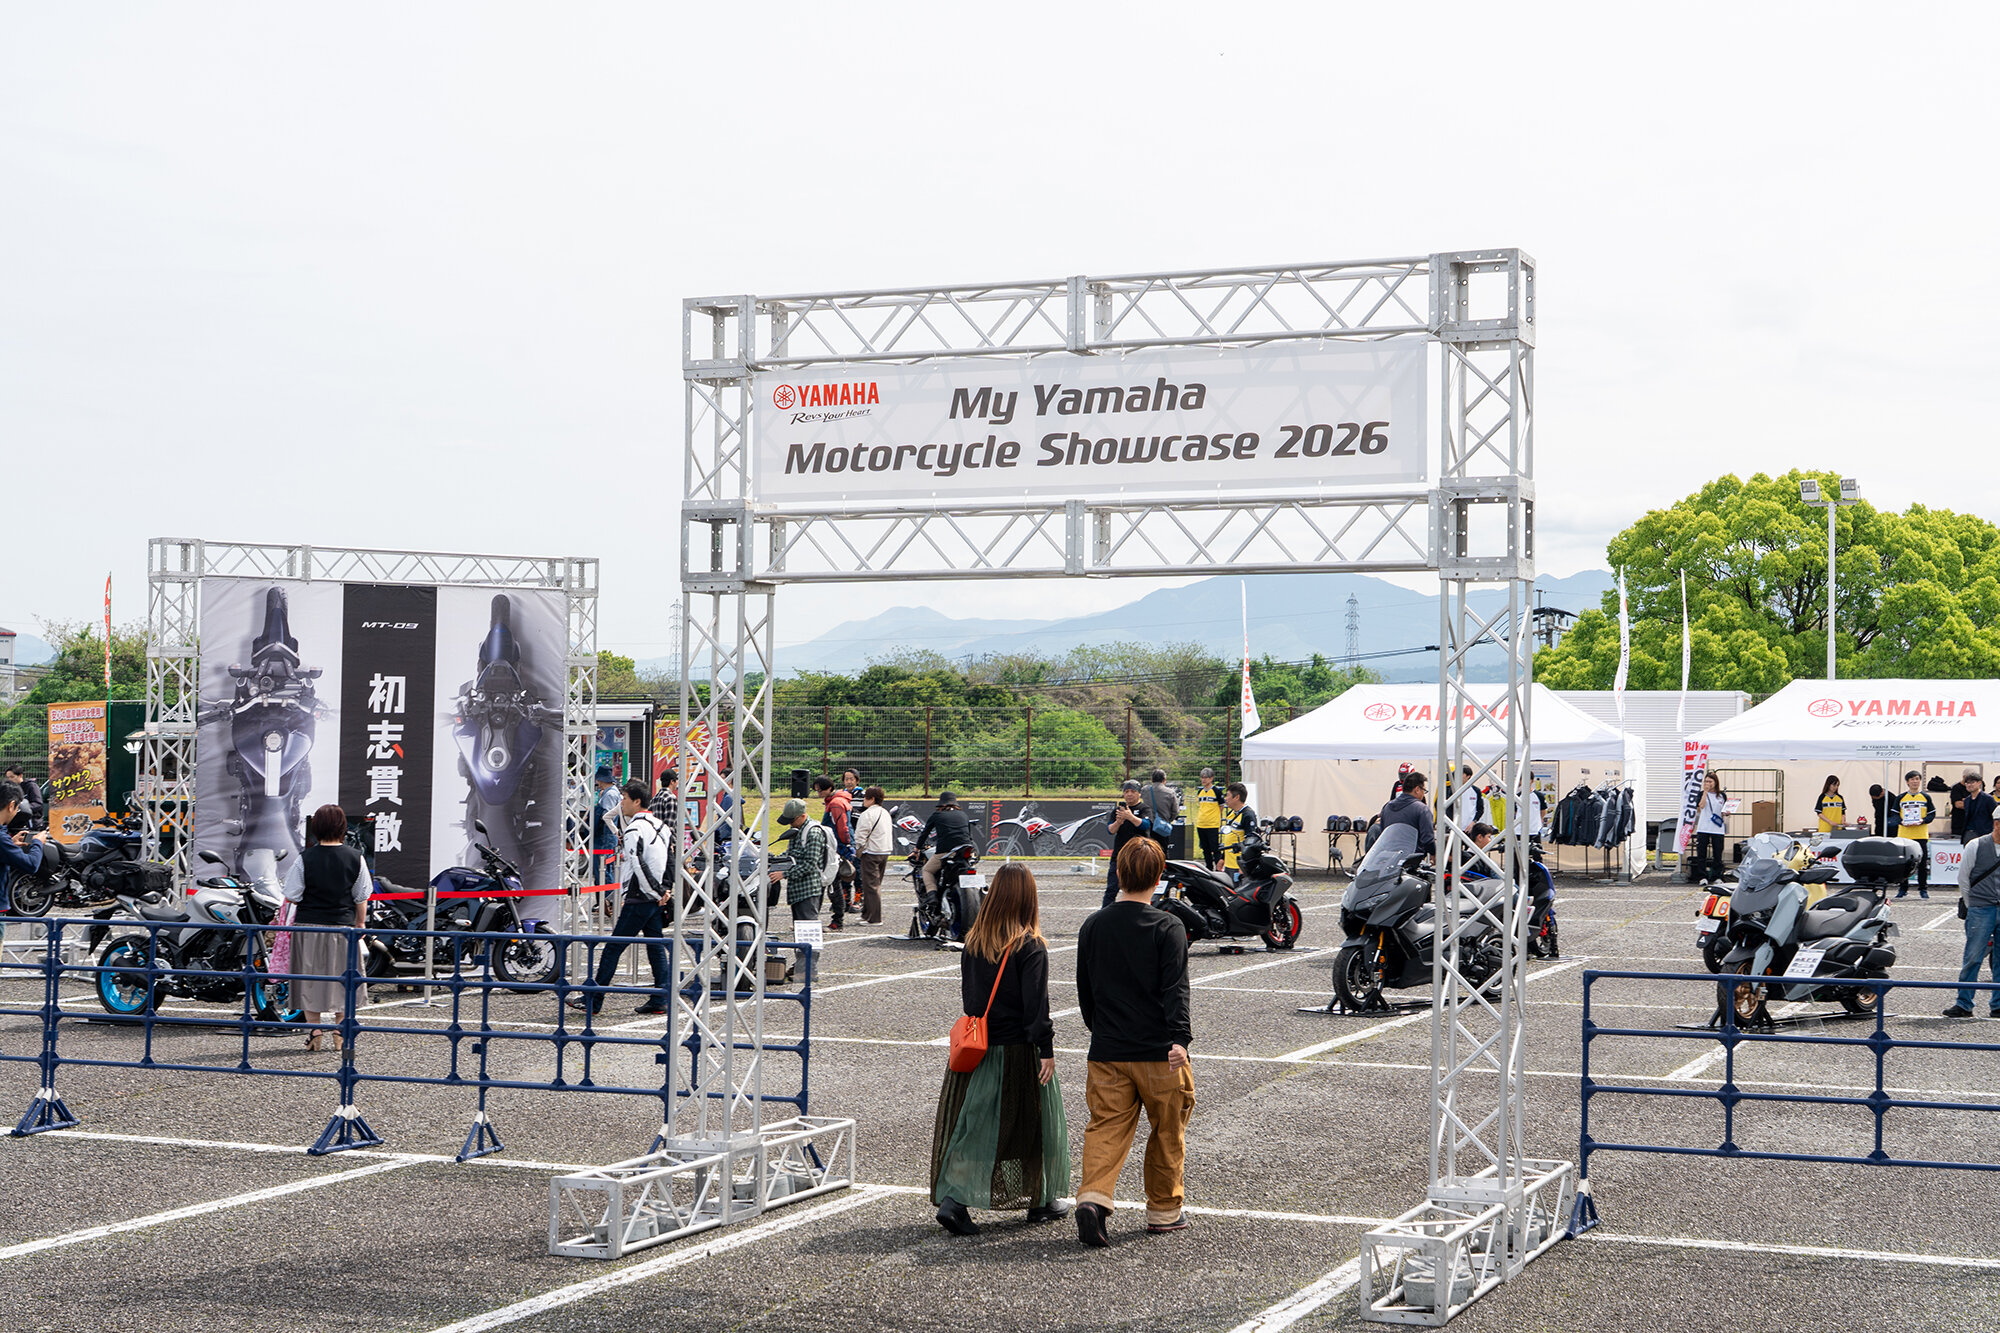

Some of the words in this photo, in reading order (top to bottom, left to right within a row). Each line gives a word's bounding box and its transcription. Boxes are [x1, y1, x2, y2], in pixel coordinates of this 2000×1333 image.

[798, 382, 880, 408] YAMAHA
[949, 387, 1019, 425] My
[1033, 377, 1207, 416] Yamaha
[789, 412, 822, 425] Revs
[822, 410, 847, 423] Your
[845, 408, 871, 418] Heart
[784, 434, 1021, 477] Motorcycle
[1036, 431, 1260, 467] Showcase
[1273, 421, 1390, 459] 2026
[361, 621, 420, 629] MT-09
[1847, 699, 1977, 717] YAMAHA
[52, 769, 91, 788] サクサク
[56, 780, 103, 800] ジューシー
